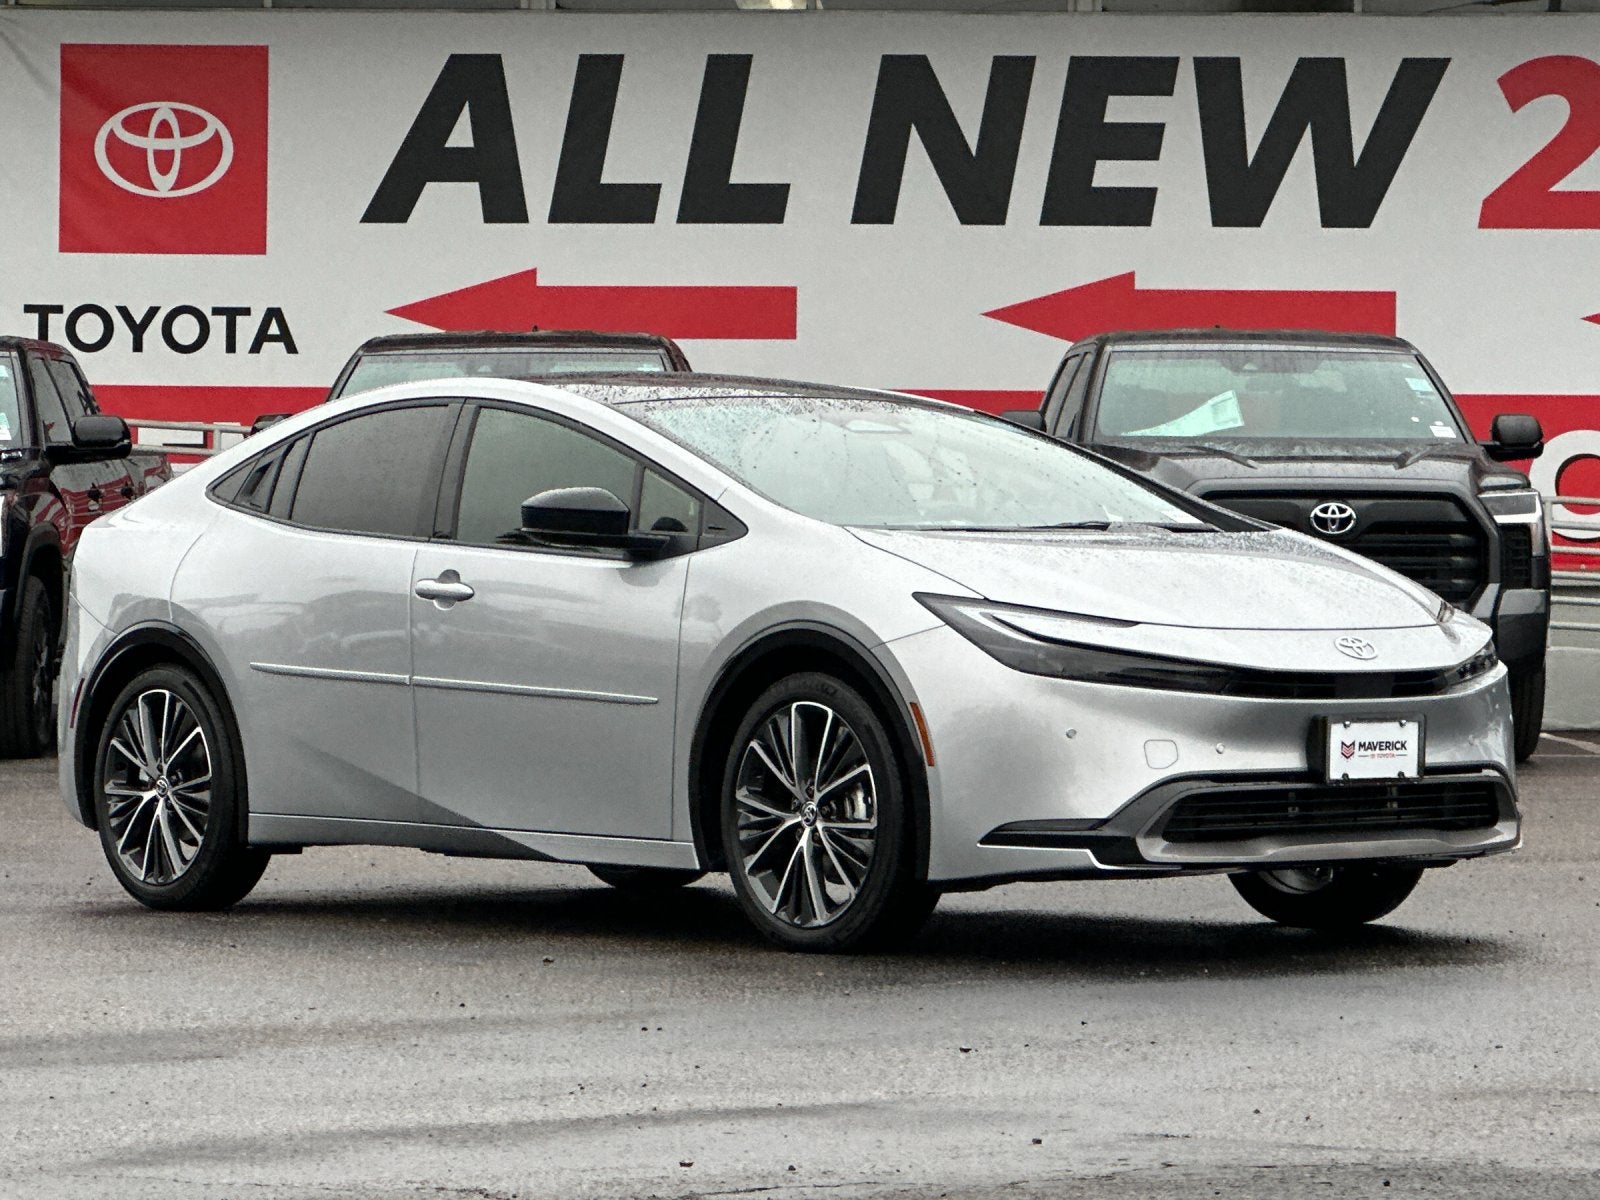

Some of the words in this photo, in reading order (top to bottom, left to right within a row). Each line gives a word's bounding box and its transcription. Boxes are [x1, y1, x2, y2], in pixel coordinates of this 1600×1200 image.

[359, 54, 791, 224] ALL
[851, 54, 1452, 228] NEW
[24, 303, 298, 356] TOYOTA
[1358, 740, 1408, 752] MAVERICK
